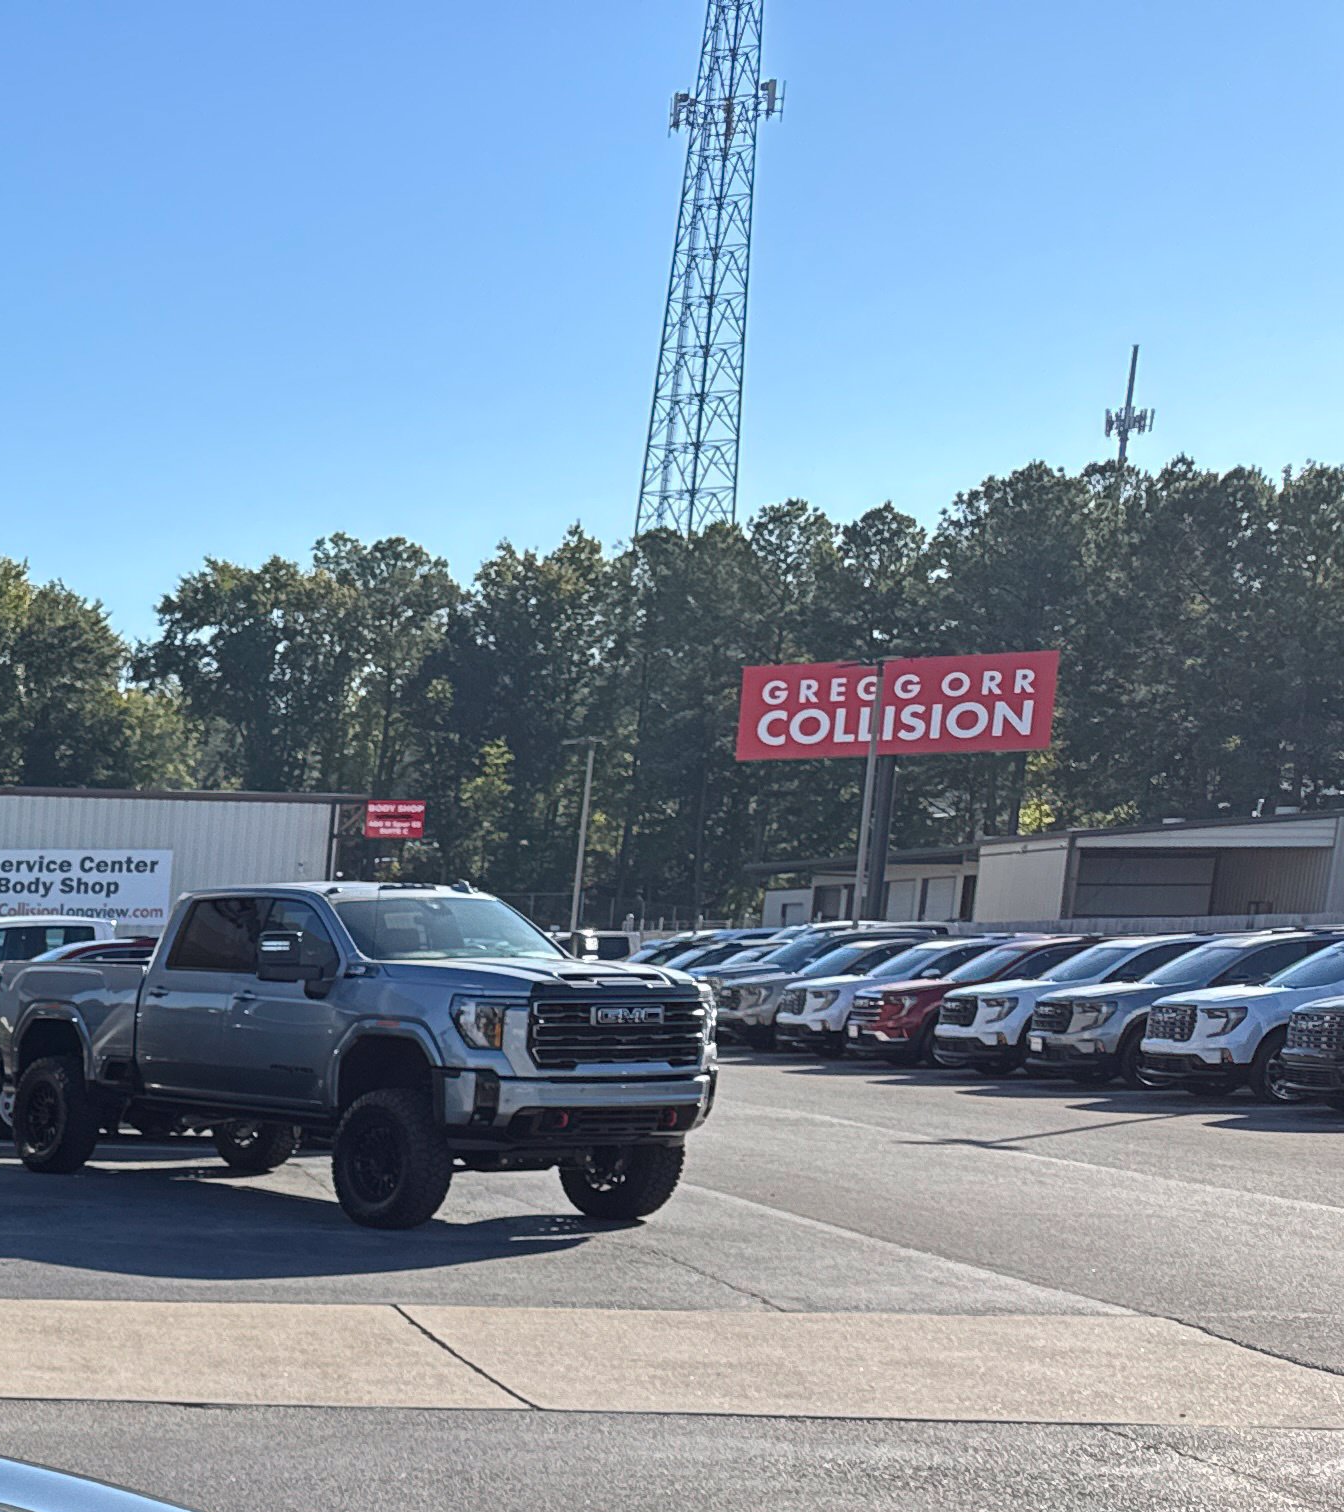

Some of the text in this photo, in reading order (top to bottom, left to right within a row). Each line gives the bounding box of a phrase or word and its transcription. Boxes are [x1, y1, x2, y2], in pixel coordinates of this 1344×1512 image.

[762, 668, 1035, 705] GREGG ORR
[757, 699, 1035, 746] COLLISION
[368, 804, 425, 813] BODY SHOP
[79, 856, 159, 873] Center
[59, 877, 120, 898] Shop
[598, 1007, 662, 1023] GMC
